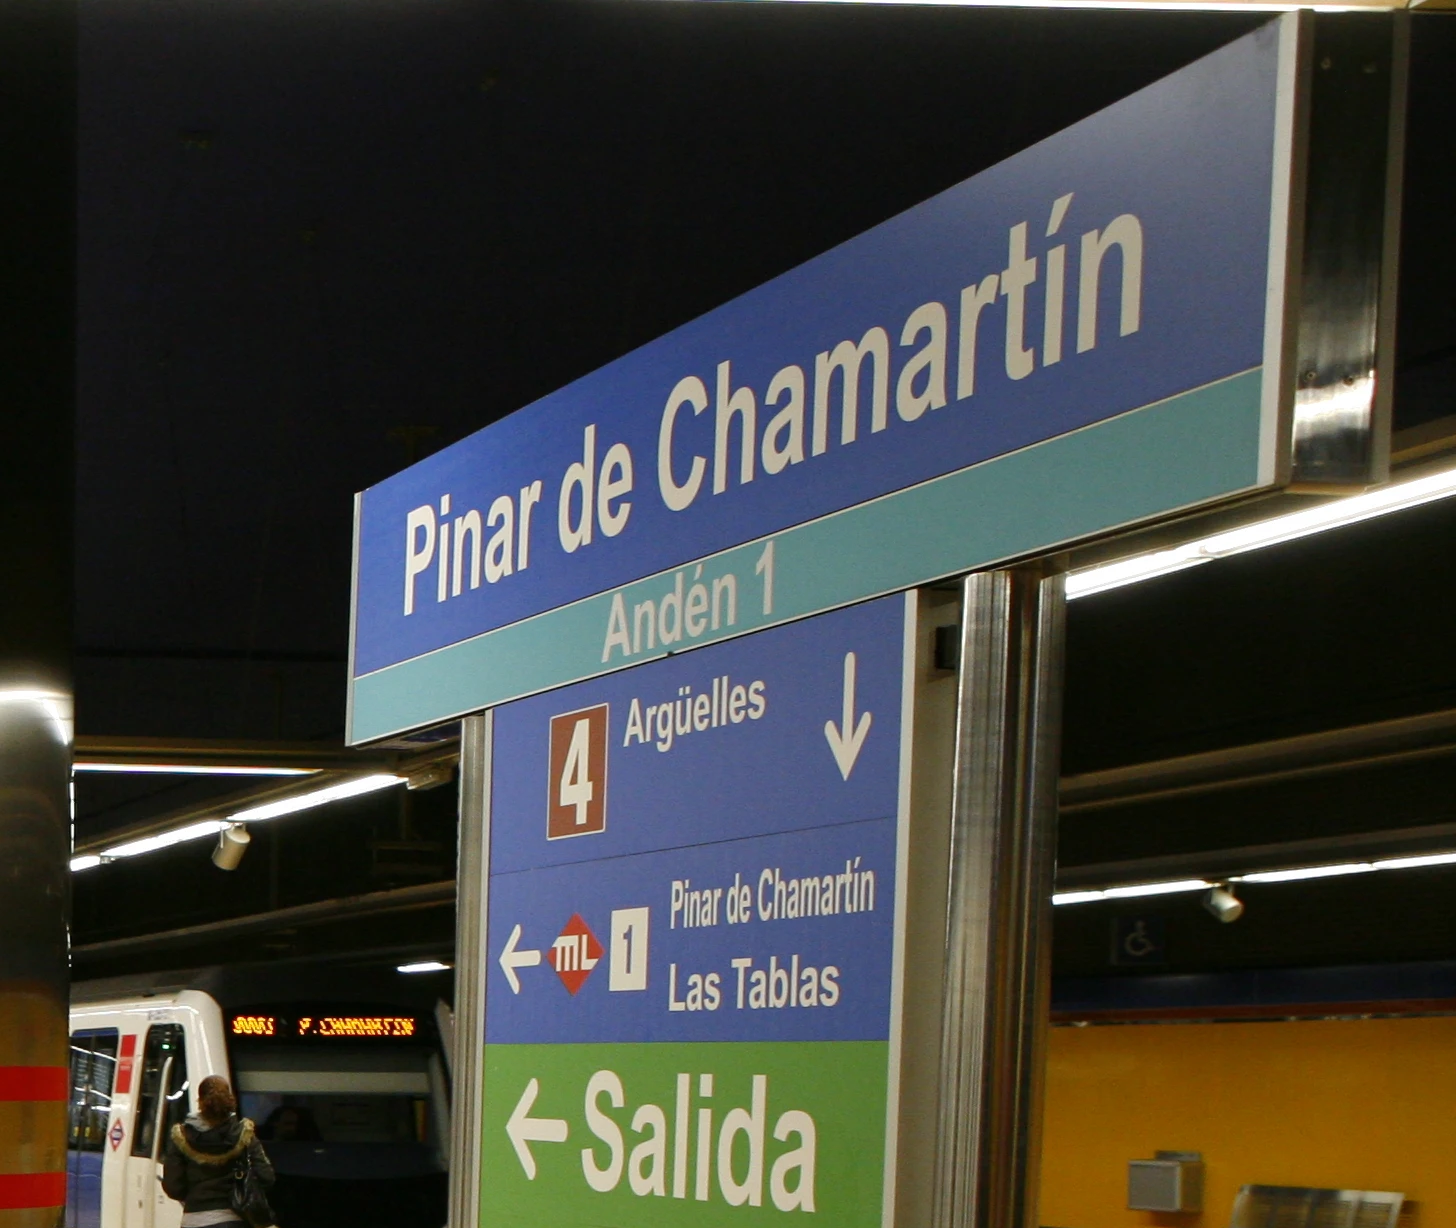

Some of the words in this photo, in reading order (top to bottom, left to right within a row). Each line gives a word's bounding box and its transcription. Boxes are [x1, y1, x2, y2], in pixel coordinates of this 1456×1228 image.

[403, 480, 542, 616] Pinar
[557, 424, 633, 553] de
[657, 191, 1144, 512] Chamartín
[601, 563, 736, 663] Andén
[755, 540, 775, 616] 1
[622, 675, 766, 752] Argüelles
[559, 717, 593, 825] 4
[670, 879, 722, 929] Pinar
[726, 873, 750, 924] de
[757, 856, 875, 921] Chamartín
[622, 924, 633, 975] 1
[668, 963, 721, 1012] Las
[731, 954, 840, 1010] Tablas
[581, 1070, 817, 1213] Salida
